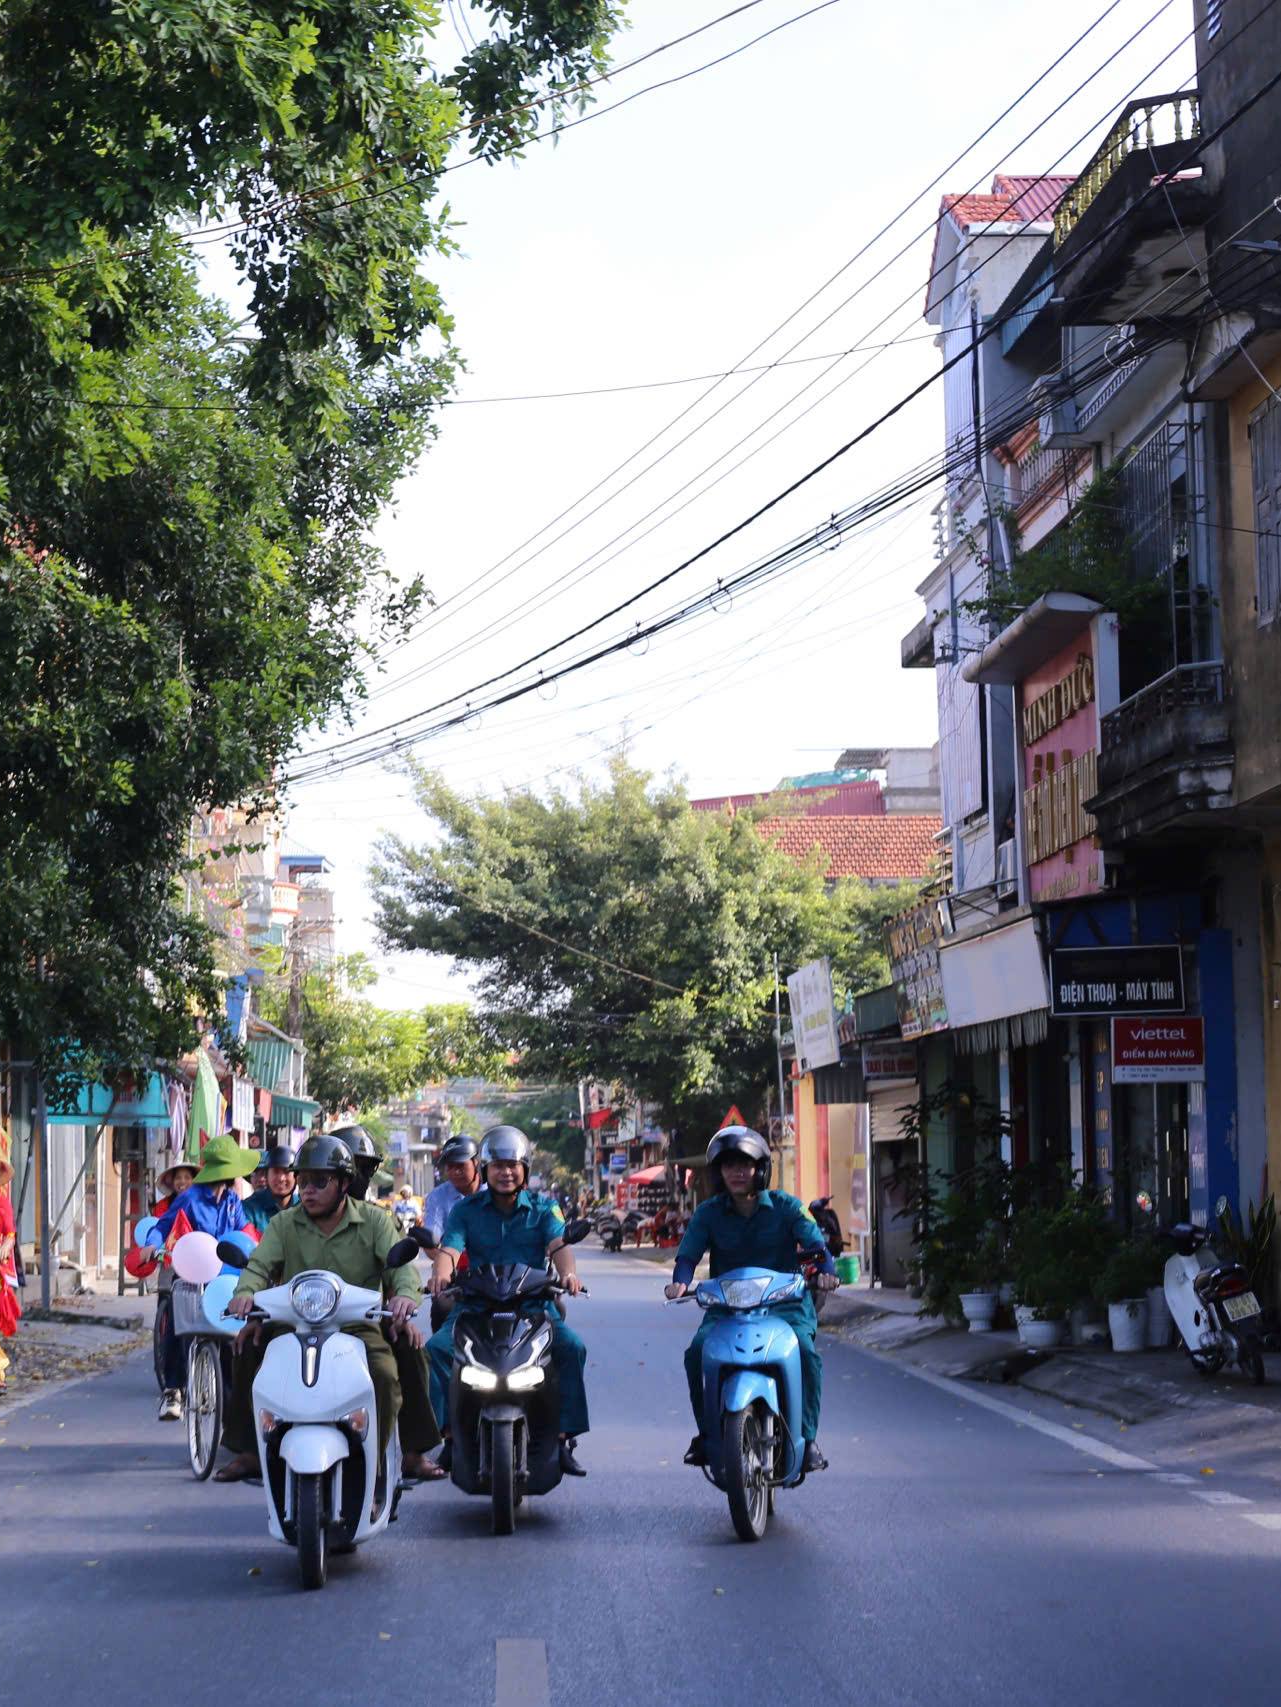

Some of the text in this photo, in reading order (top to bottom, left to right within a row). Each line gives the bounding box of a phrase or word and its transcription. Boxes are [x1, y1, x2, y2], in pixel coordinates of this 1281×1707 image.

[1060, 980, 1084, 1007] ĐIỆN
[1087, 983, 1117, 1006] THOẠI
[1125, 978, 1148, 1001] MÁY
[1130, 1028, 1187, 1041] viettel
[1122, 1047, 1195, 1059] ĐIỂM BÁN HÀNG
